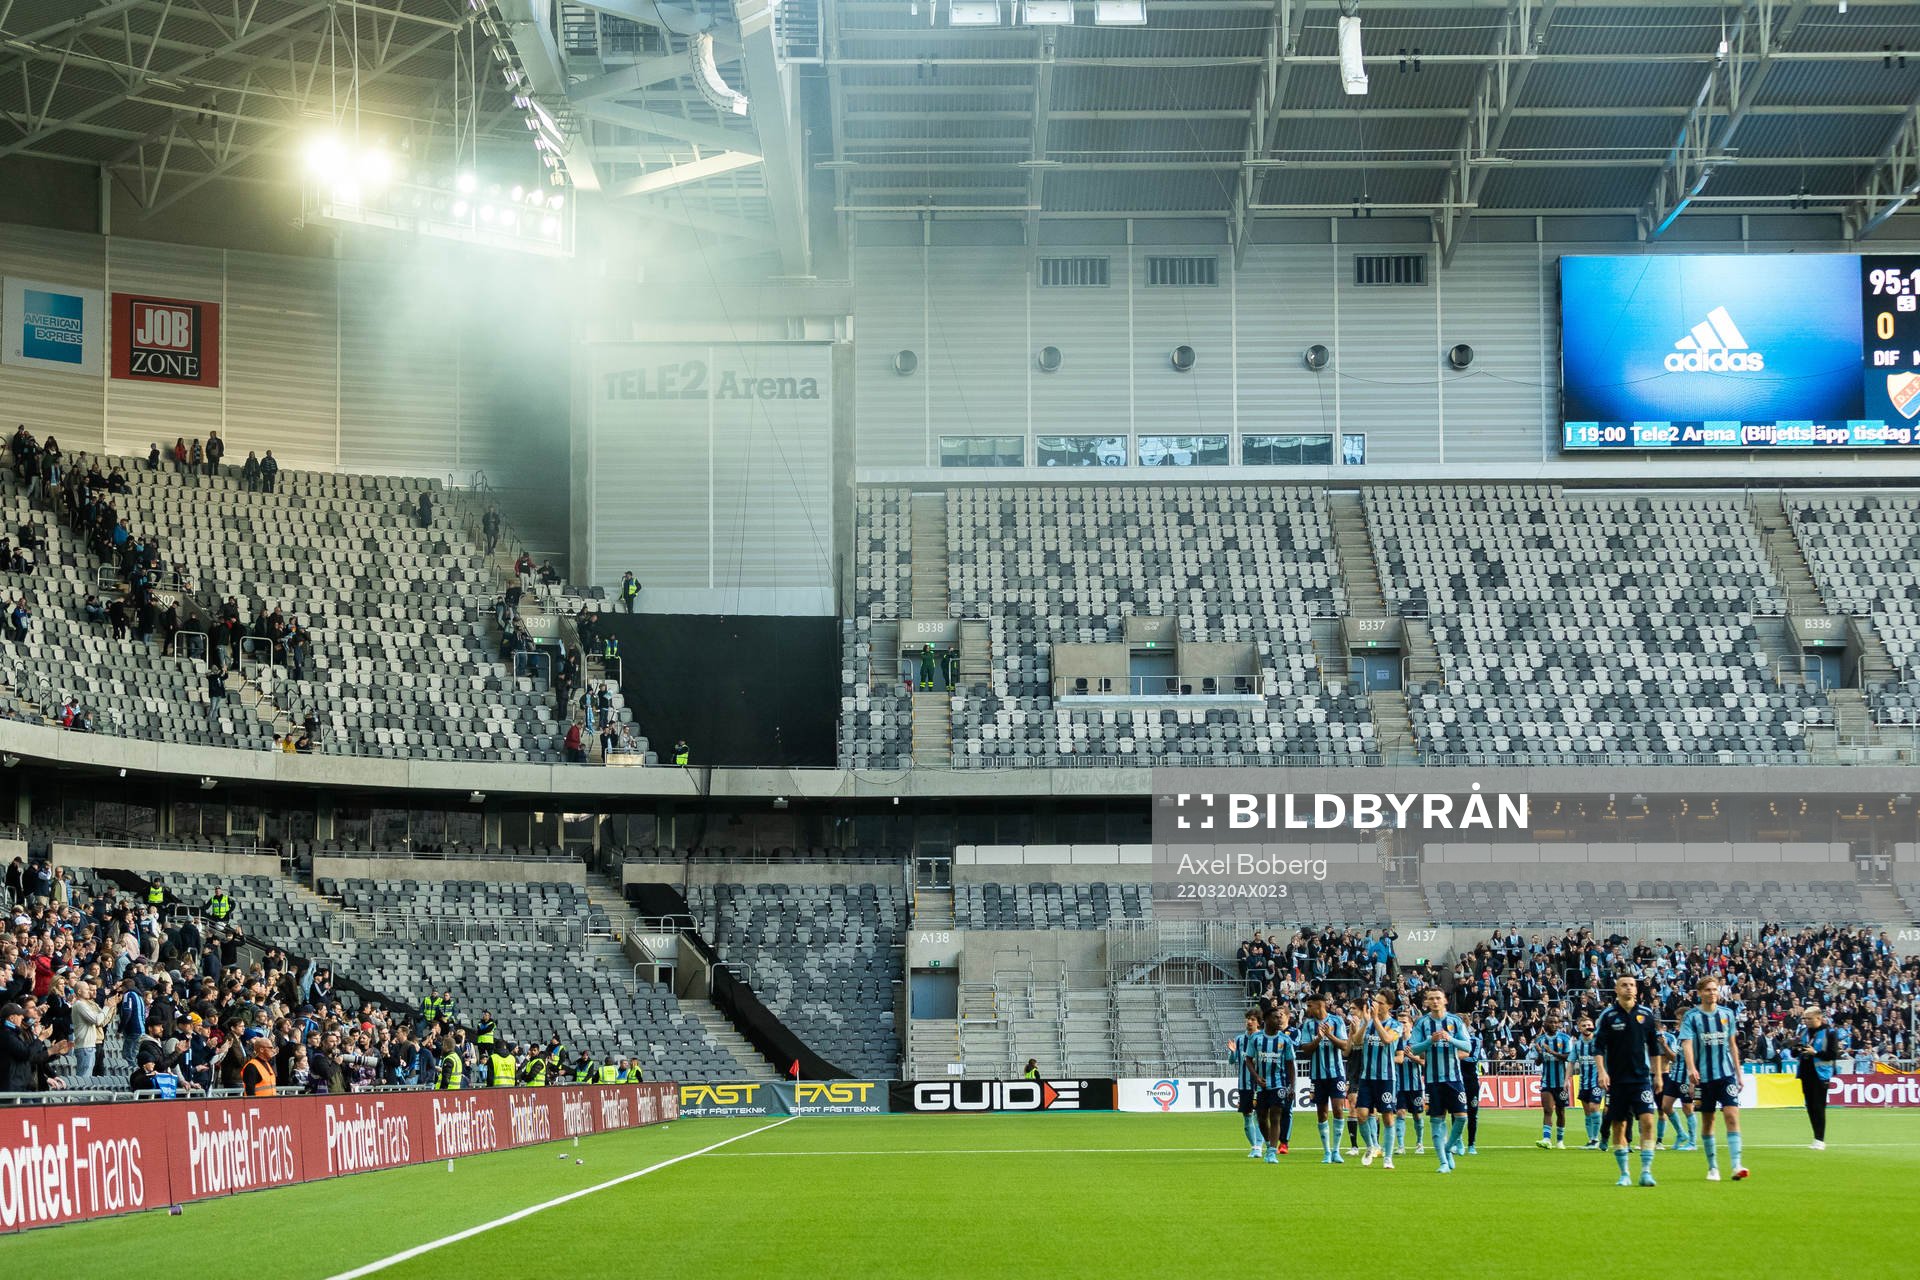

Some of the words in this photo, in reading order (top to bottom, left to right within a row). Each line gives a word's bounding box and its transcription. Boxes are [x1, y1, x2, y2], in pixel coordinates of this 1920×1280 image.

[24, 313, 79, 331] AMERICAN
[137, 308, 189, 348] JOB
[1877, 312, 1895, 340] 0
[36, 328, 83, 344] EXPRESS
[131, 351, 199, 377] ZONE
[1664, 347, 1764, 372] adidas
[1874, 350, 1900, 366] DIF
[606, 360, 709, 401] TELE2
[714, 370, 820, 400] Arena
[1578, 427, 1626, 442] 19:00
[1630, 426, 1679, 442] Tele2
[1682, 426, 1736, 442] Arena
[1853, 424, 1911, 444] tisdag
[526, 617, 551, 628] B301
[917, 622, 944, 633] B338
[1359, 620, 1386, 632] B337
[1805, 618, 1832, 630] B336
[919, 932, 950, 944] A138
[1407, 929, 1437, 942] A137
[681, 1083, 761, 1106] FAST
[795, 1082, 875, 1104] FAST
[913, 1081, 1080, 1111] GUIDE
